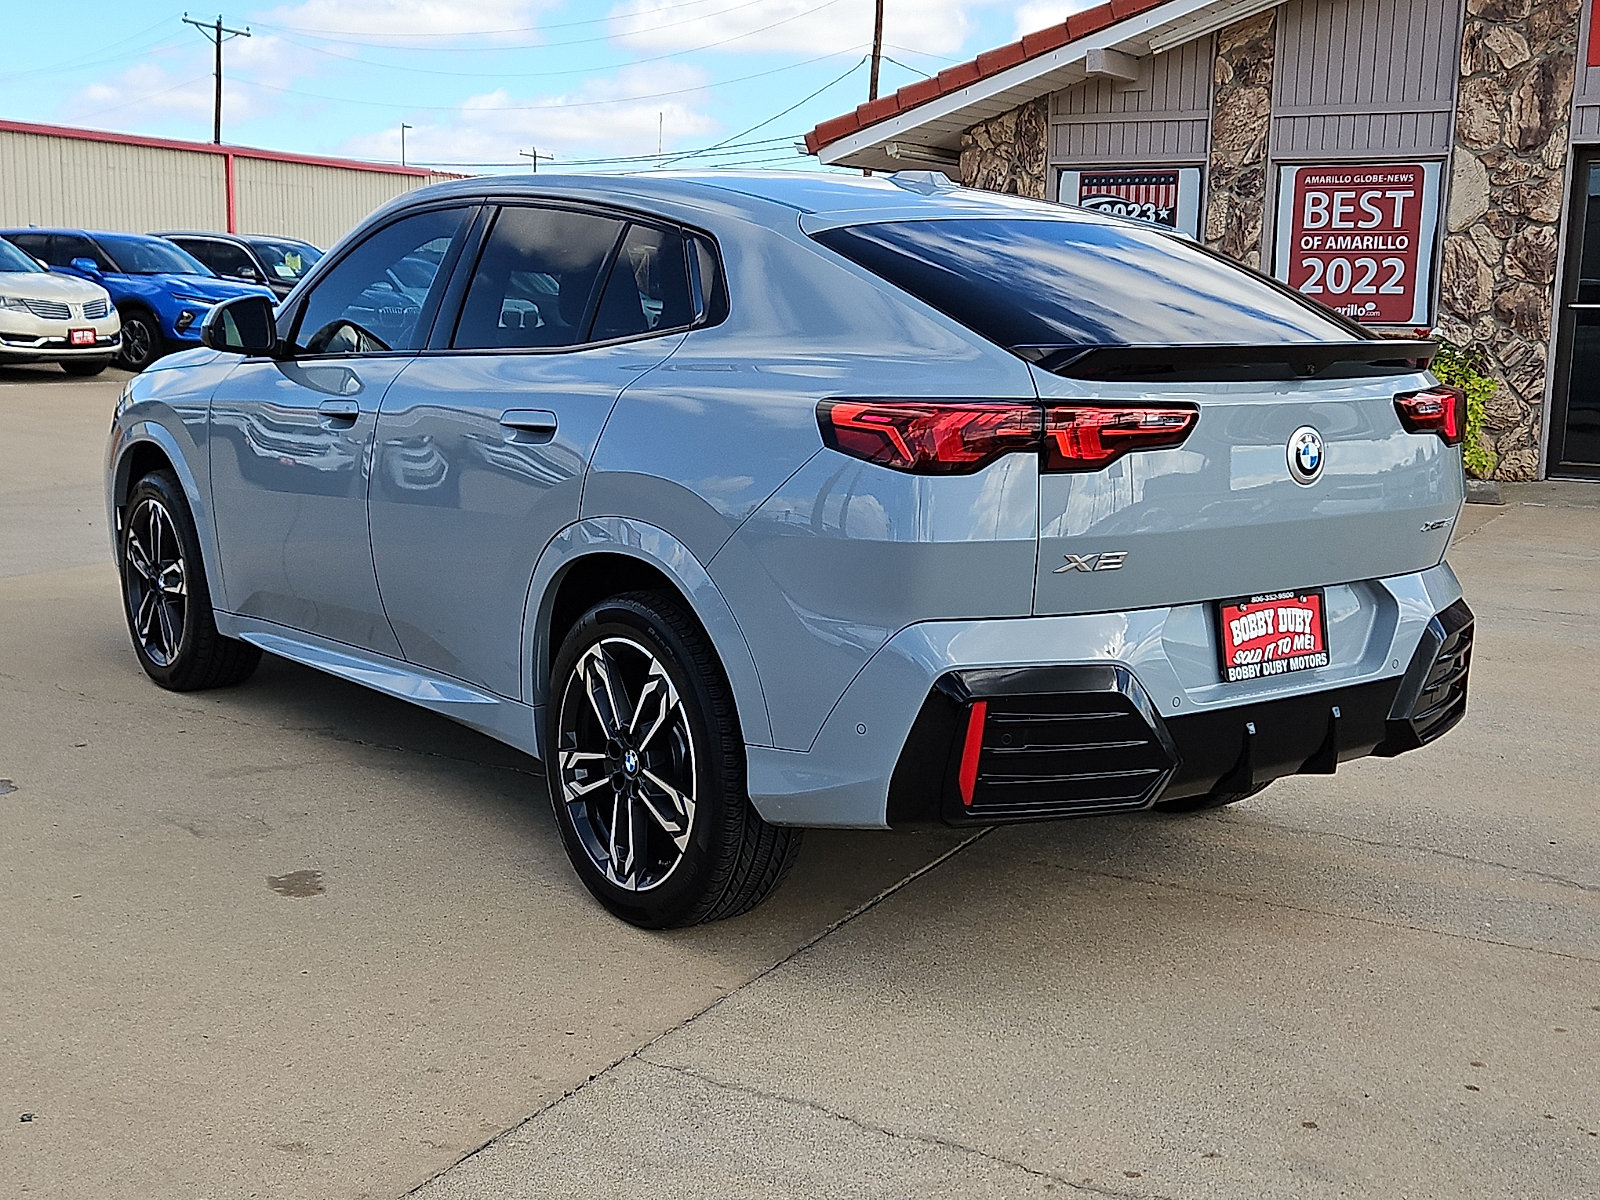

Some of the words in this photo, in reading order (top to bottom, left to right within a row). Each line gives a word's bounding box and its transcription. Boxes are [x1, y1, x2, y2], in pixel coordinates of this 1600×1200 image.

[1305, 175, 1352, 184] AMARILLO
[1354, 173, 1414, 183] GLOBE-NEWS
[1303, 190, 1415, 229] BEST
[1300, 236, 1323, 250] OF
[1325, 235, 1409, 250] AMARILLO
[1298, 257, 1405, 295] 2022
[1230, 609, 1274, 646] BOBBY
[1278, 608, 1313, 633] DUBY
[1233, 648, 1263, 665] SOLD
[1264, 642, 1276, 661] IT
[1277, 637, 1292, 655] TO
[1228, 663, 1261, 681] BOBBY
[1262, 659, 1288, 676] DUBY
[1289, 653, 1328, 671] MOTORS
